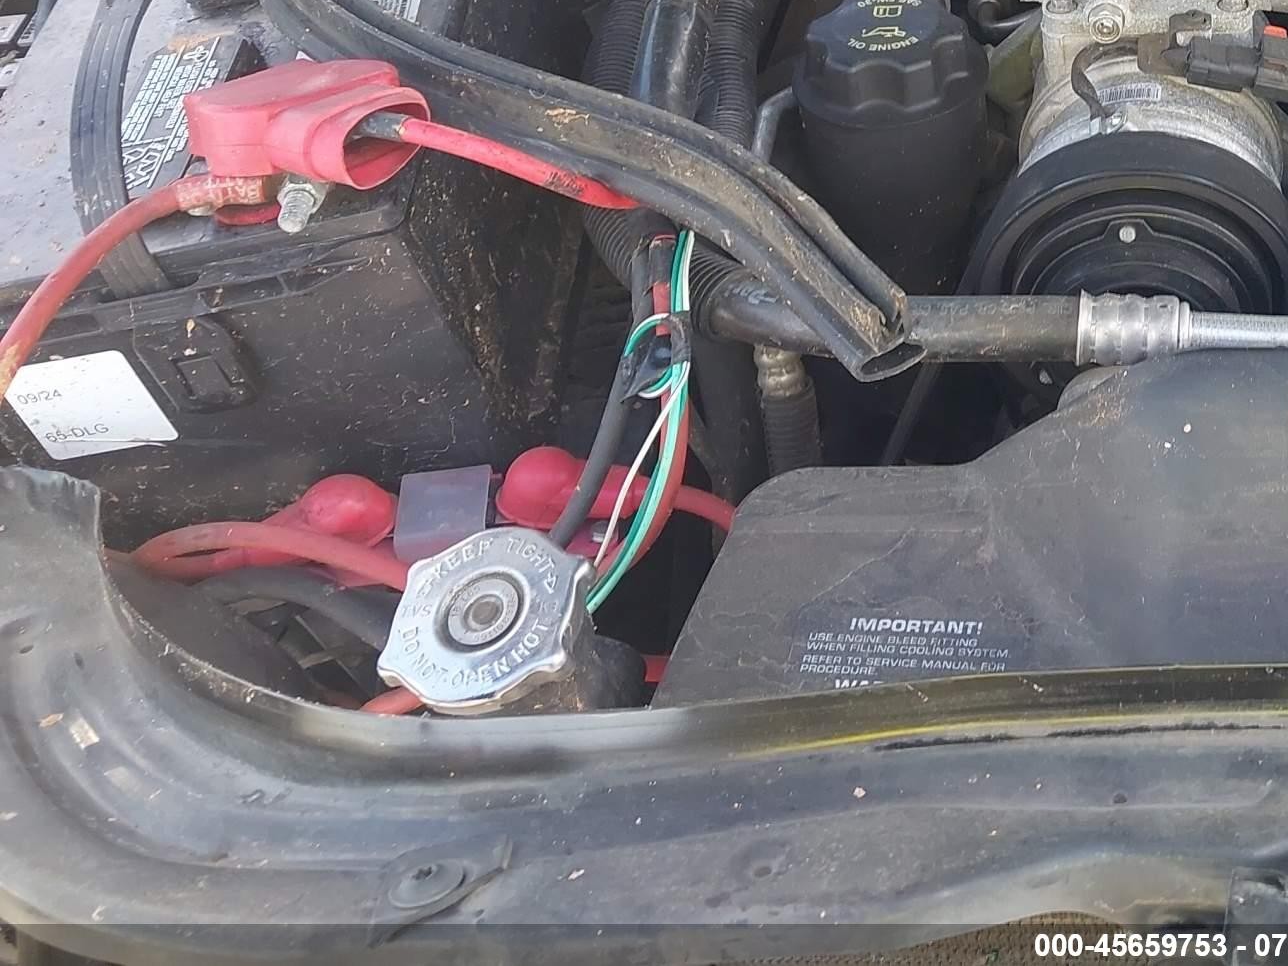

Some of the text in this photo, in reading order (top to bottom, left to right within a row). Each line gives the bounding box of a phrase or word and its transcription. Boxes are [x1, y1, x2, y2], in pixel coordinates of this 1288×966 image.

[847, 36, 919, 51] ENGINE OIL
[17, 389, 63, 405] 09/24
[44, 423, 110, 443] 65-DLG
[433, 537, 556, 578] KEEP TIGHT
[850, 617, 984, 635] IMPORTANT!
[808, 632, 978, 648] USE ENGINE BLEED FITTING
[400, 620, 549, 687] DO NOT OPEN HOT
[806, 642, 1011, 659] WHEN FILLING COOLING SYSTEM.
[800, 664, 878, 675] PROCEDURE.
[802, 654, 1006, 672] REFER TO SERVICE MANUAL FOR
